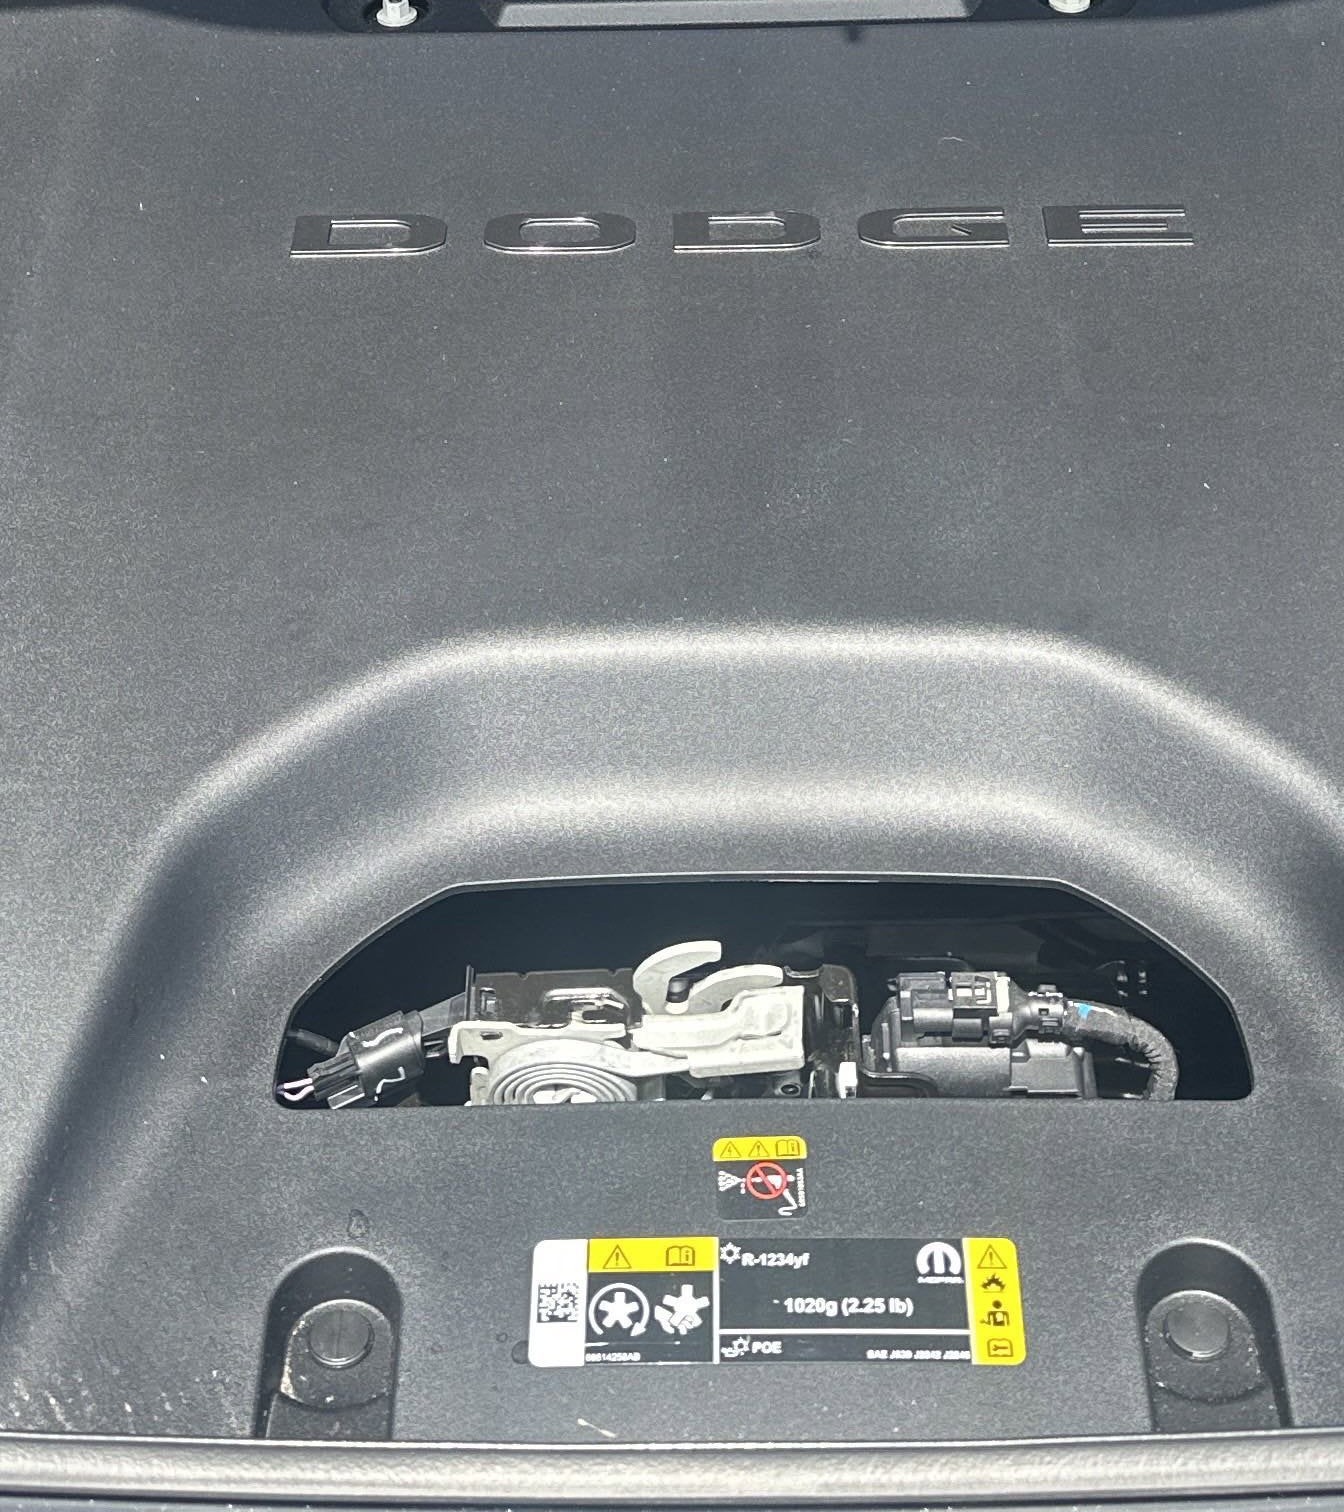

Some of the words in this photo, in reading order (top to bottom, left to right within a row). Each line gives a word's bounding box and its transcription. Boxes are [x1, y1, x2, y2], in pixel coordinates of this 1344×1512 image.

[290, 204, 1194, 258] DODGE
[741, 1252, 811, 1269] R-1234yf
[783, 1297, 838, 1317] 1020g
[841, 1297, 886, 1317] (2.25
[888, 1297, 914, 1317] lb)
[751, 1340, 783, 1355] POE
